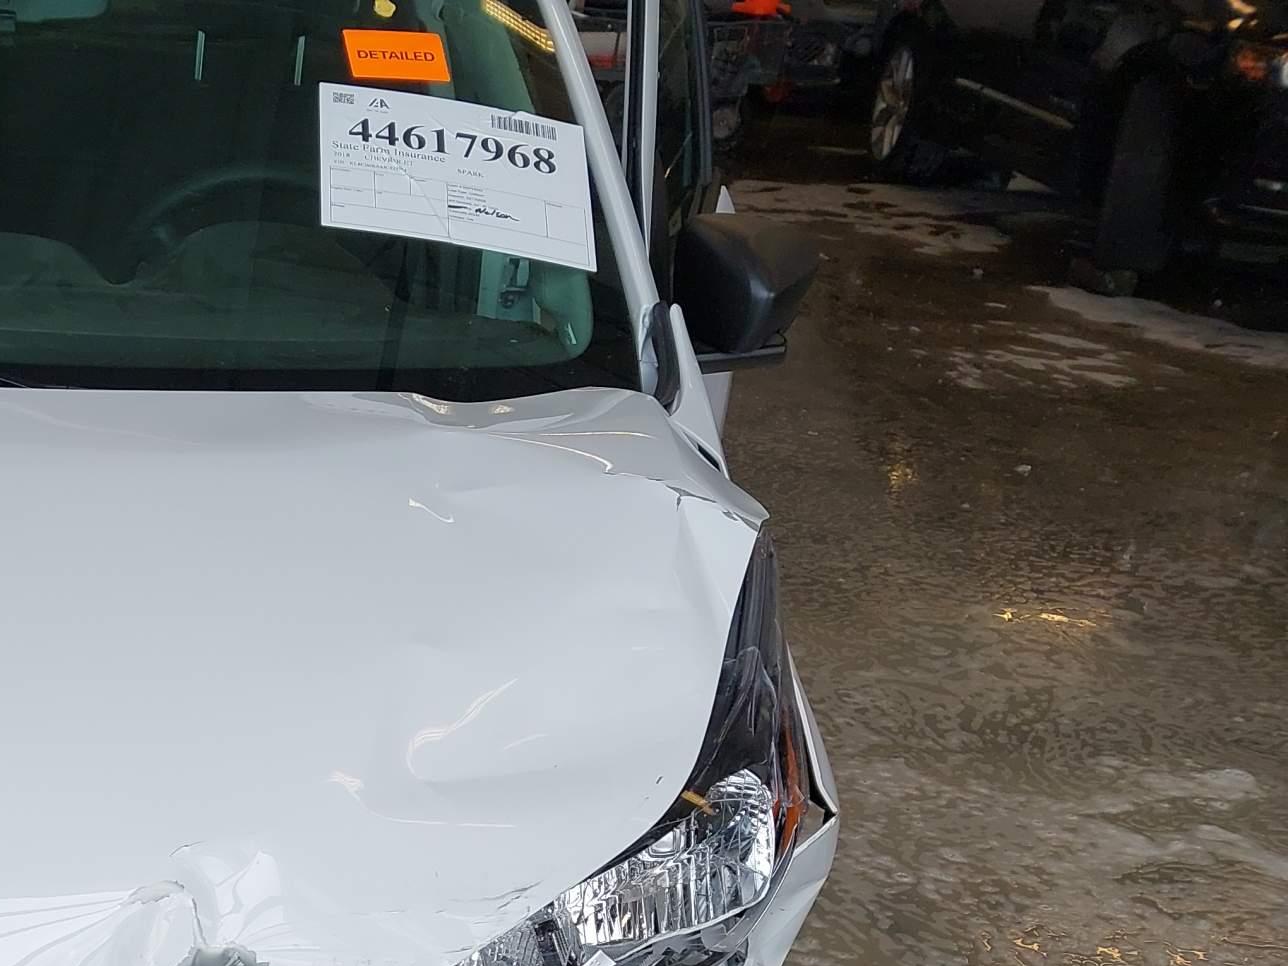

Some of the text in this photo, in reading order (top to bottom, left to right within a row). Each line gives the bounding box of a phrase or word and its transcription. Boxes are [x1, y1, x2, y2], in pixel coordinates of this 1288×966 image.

[357, 50, 435, 62] DETAILED
[332, 141, 359, 151] State
[394, 148, 446, 163] Insurance
[348, 118, 557, 174] 44617968
